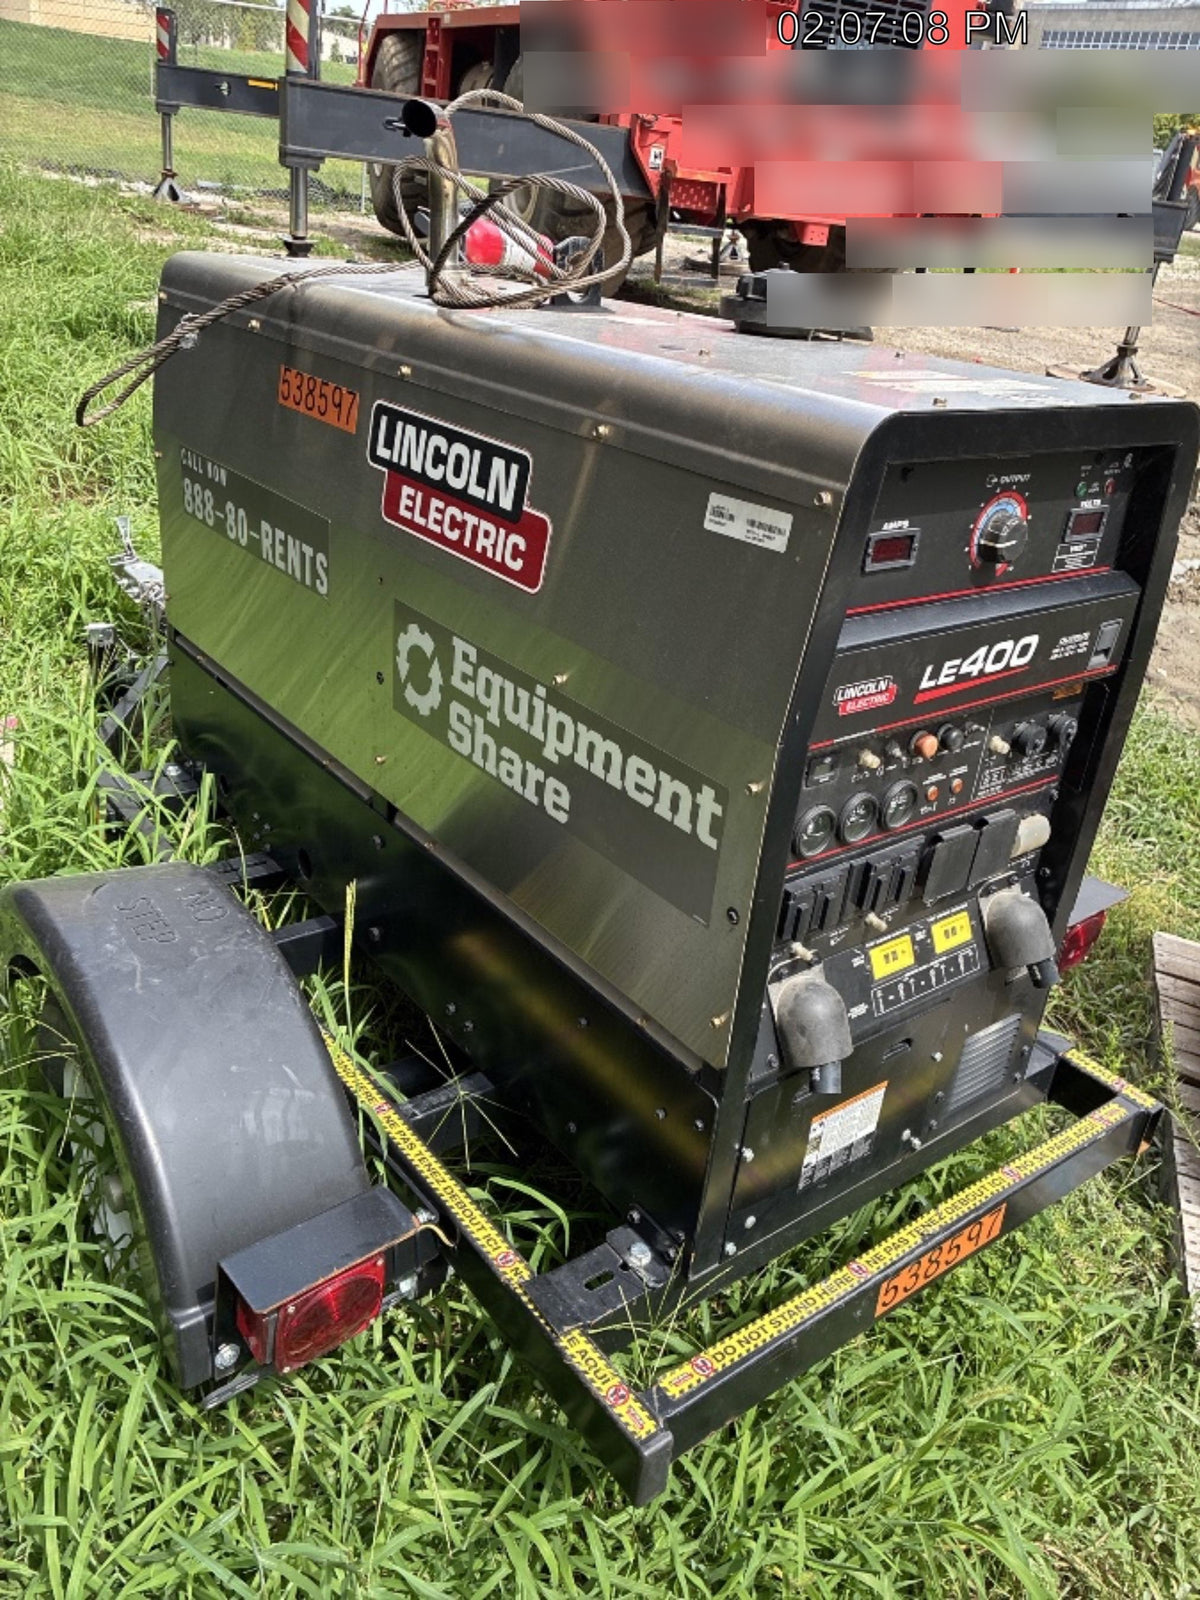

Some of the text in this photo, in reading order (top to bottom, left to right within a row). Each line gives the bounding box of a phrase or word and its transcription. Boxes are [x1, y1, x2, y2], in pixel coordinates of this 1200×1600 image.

[279, 367, 358, 427] 538597
[181, 447, 203, 474] CALL
[376, 414, 519, 511] LINCOLN
[1000, 473, 1031, 484] OUTPUT
[183, 477, 328, 595] 888-80-RENTS
[398, 484, 527, 572] ELECTRIC
[837, 680, 891, 702] LINCOLN
[919, 634, 1040, 691] LE400
[845, 694, 890, 713] ELECTRIC
[447, 699, 571, 825] Share
[450, 635, 723, 851] Equipment
[114, 896, 179, 944] STEP
[1050, 1133, 1078, 1152] PARE
[383, 1112, 502, 1252] NE PAS TENEZ DEBOUT ICI
[866, 1249, 887, 1268] NE
[884, 1237, 910, 1258] PAS
[943, 1182, 989, 1215] DEBOUT
[988, 1176, 1006, 1192] ICI
[880, 1206, 1005, 1308] 538597
[712, 1273, 855, 1364] DO NOT STAND HERE
[575, 1348, 612, 1386] AQUI
